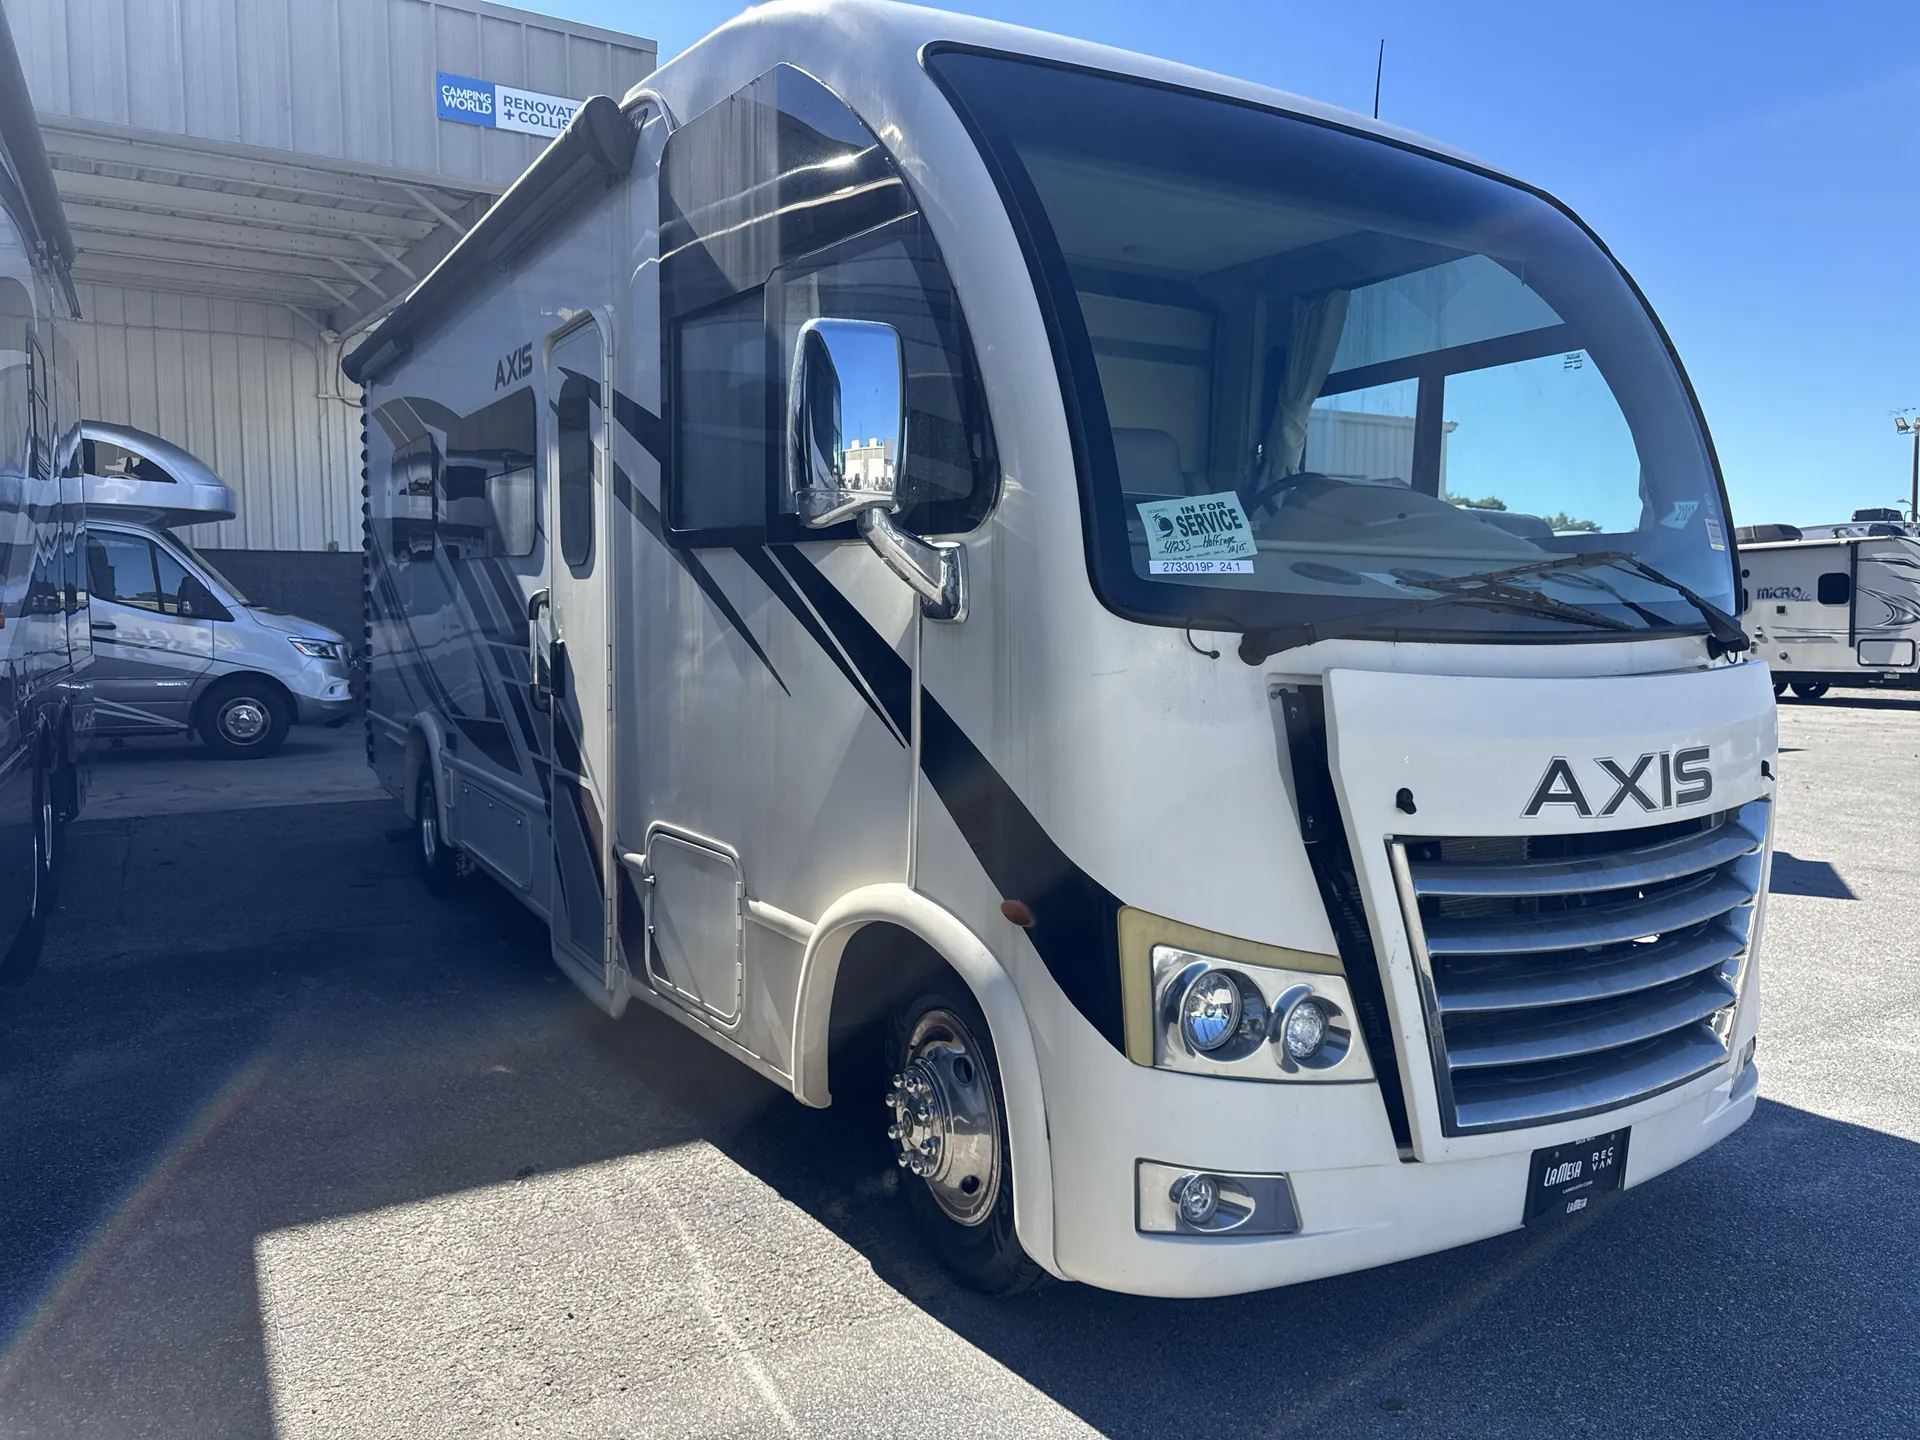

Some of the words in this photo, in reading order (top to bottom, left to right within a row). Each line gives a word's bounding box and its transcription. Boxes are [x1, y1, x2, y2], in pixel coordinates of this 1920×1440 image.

[441, 85, 492, 104] CAMPING
[442, 94, 493, 115] WORLD
[503, 95, 577, 118] RENOVAT
[494, 341, 533, 391] AXIS
[1180, 504, 1196, 515] IN
[1198, 501, 1227, 512] FOR
[1175, 508, 1243, 538] SERVICE
[1162, 561, 1214, 572] 2733019P
[1219, 561, 1241, 572] 24.1
[1519, 744, 1713, 819] AXIS
[1592, 1146, 1614, 1162] REC
[1592, 1156, 1613, 1171] VAN
